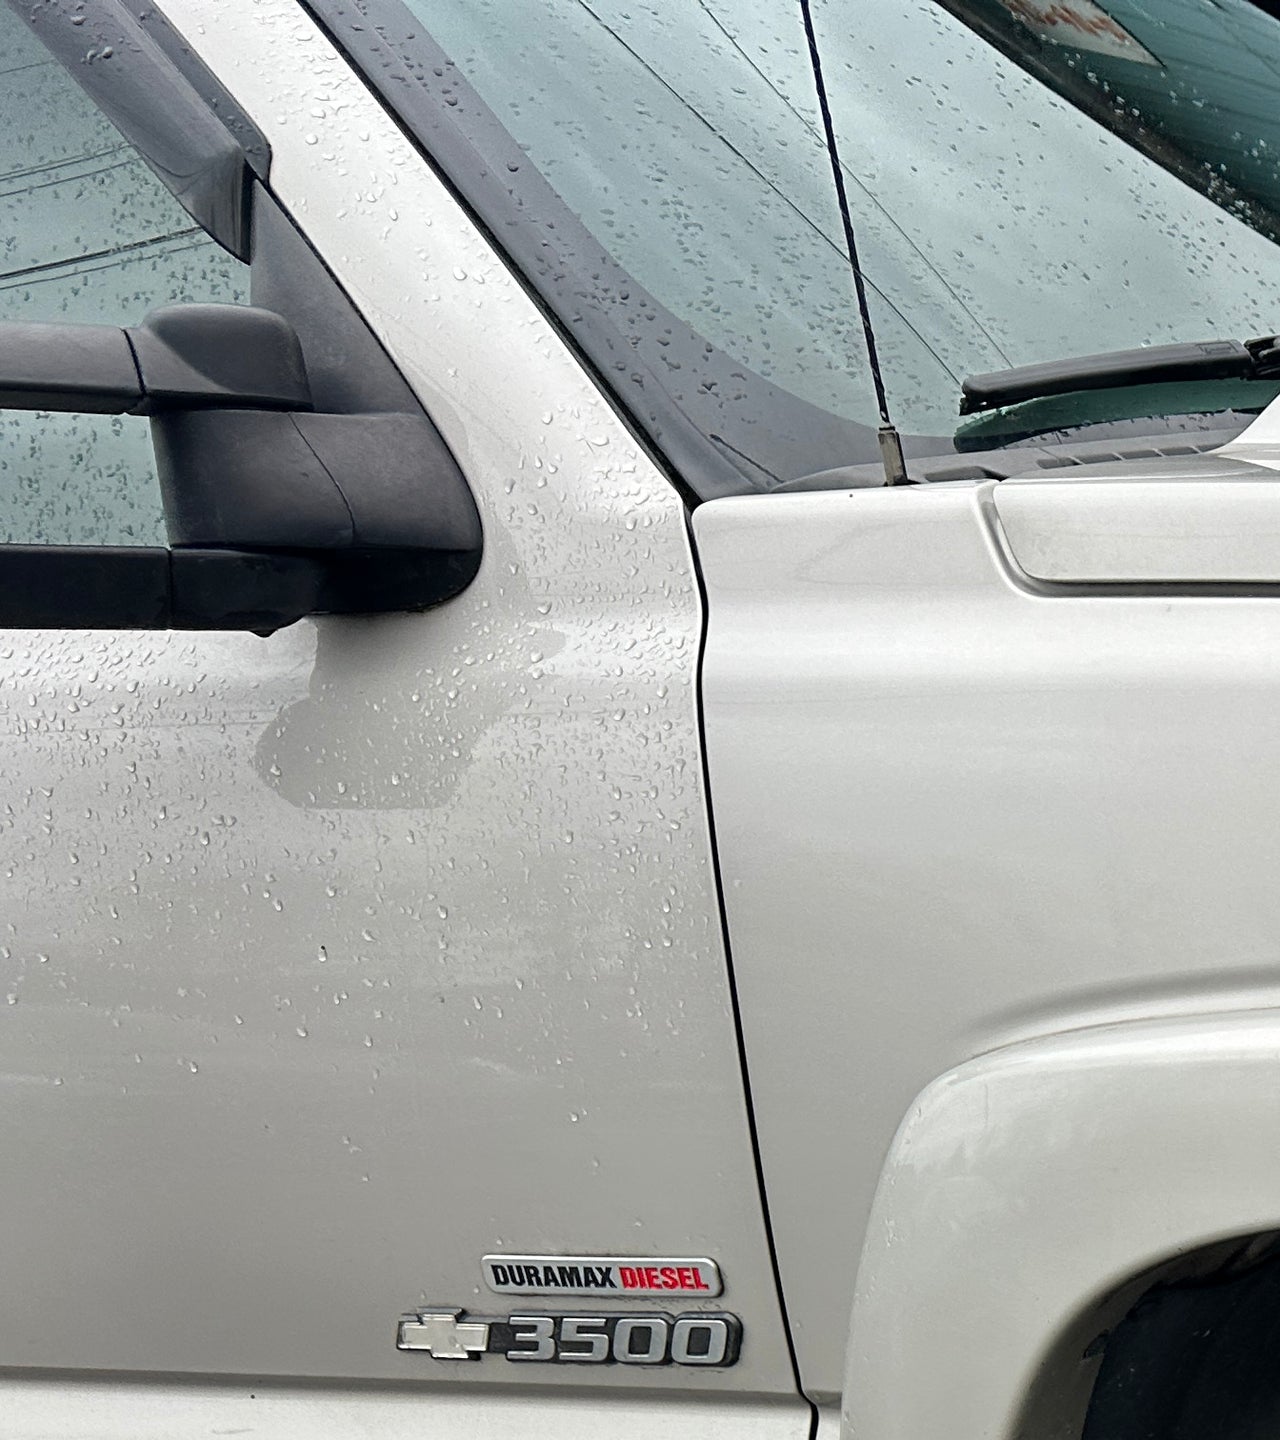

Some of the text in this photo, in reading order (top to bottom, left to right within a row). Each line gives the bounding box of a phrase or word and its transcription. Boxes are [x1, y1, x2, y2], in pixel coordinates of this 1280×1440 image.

[490, 1263, 711, 1291] DURAMAX DIESEL
[507, 1315, 729, 1365] 3500
